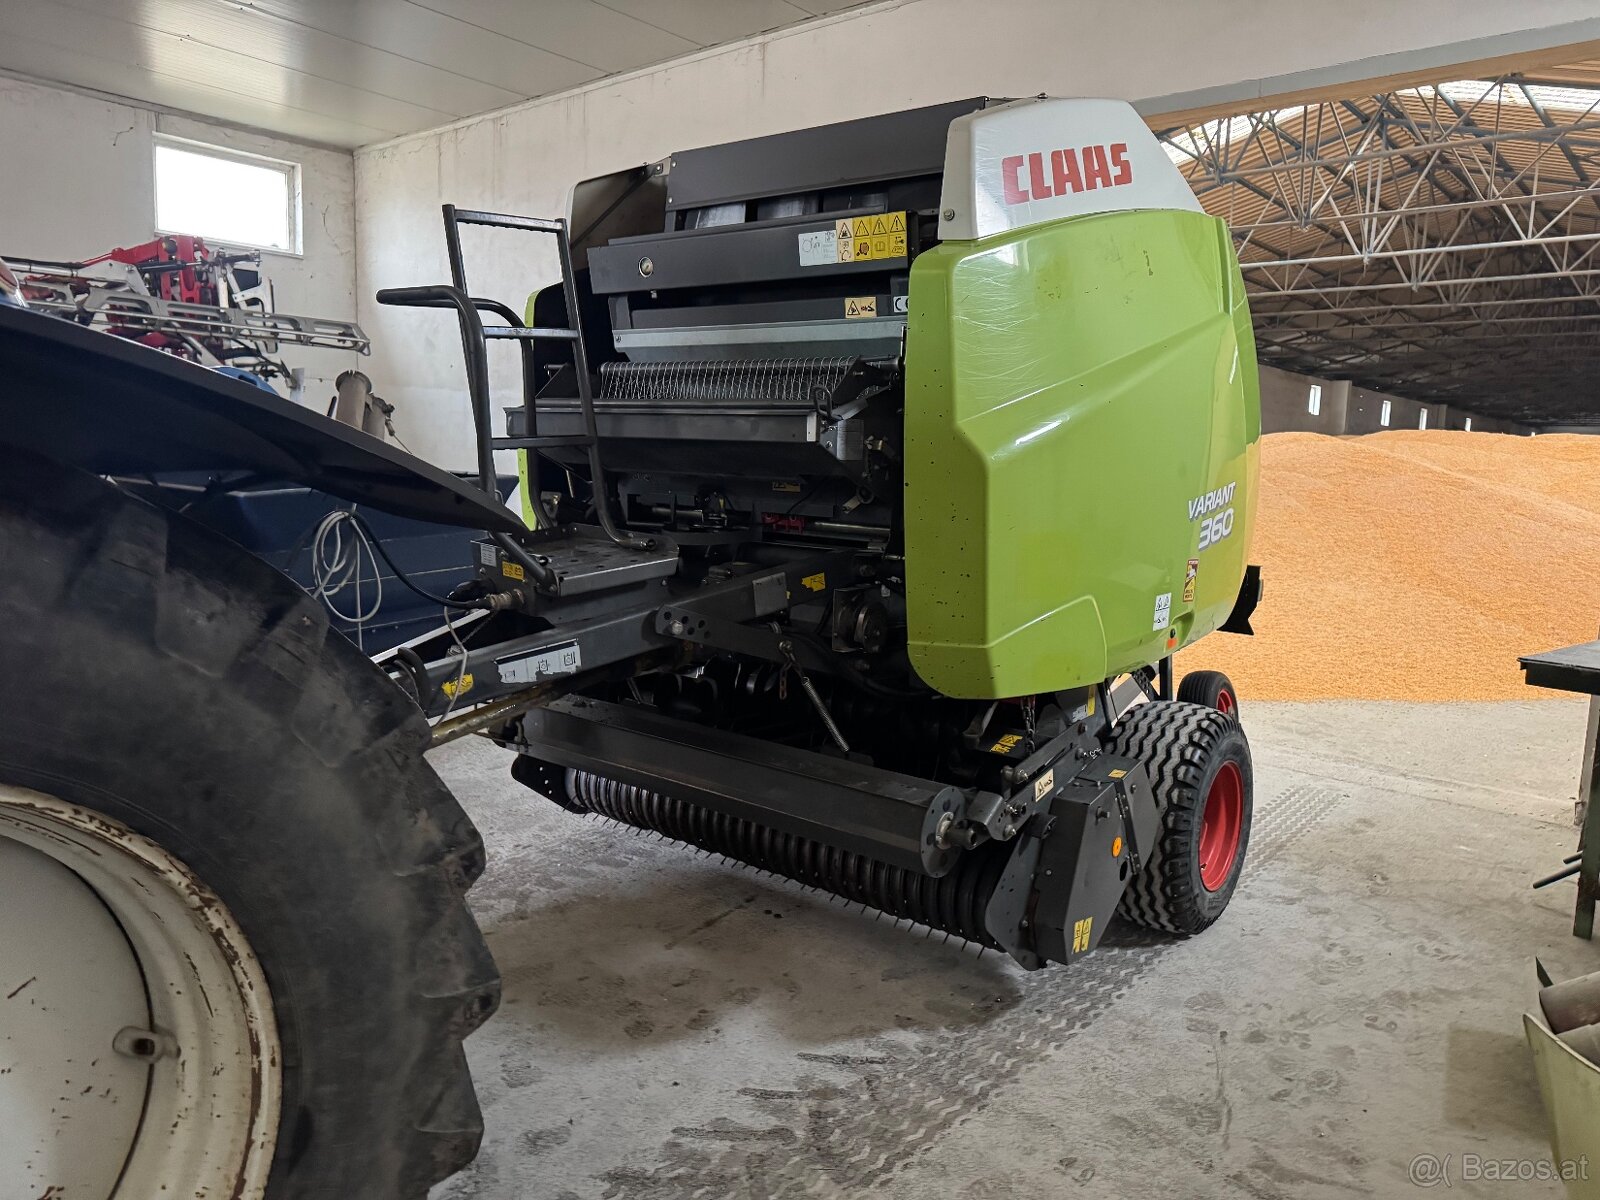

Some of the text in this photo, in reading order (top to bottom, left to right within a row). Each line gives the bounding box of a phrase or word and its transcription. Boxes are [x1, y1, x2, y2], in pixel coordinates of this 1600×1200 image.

[1003, 143, 1132, 205] CLAAS
[1188, 483, 1236, 520] VARIANT
[1199, 508, 1234, 549] 360
